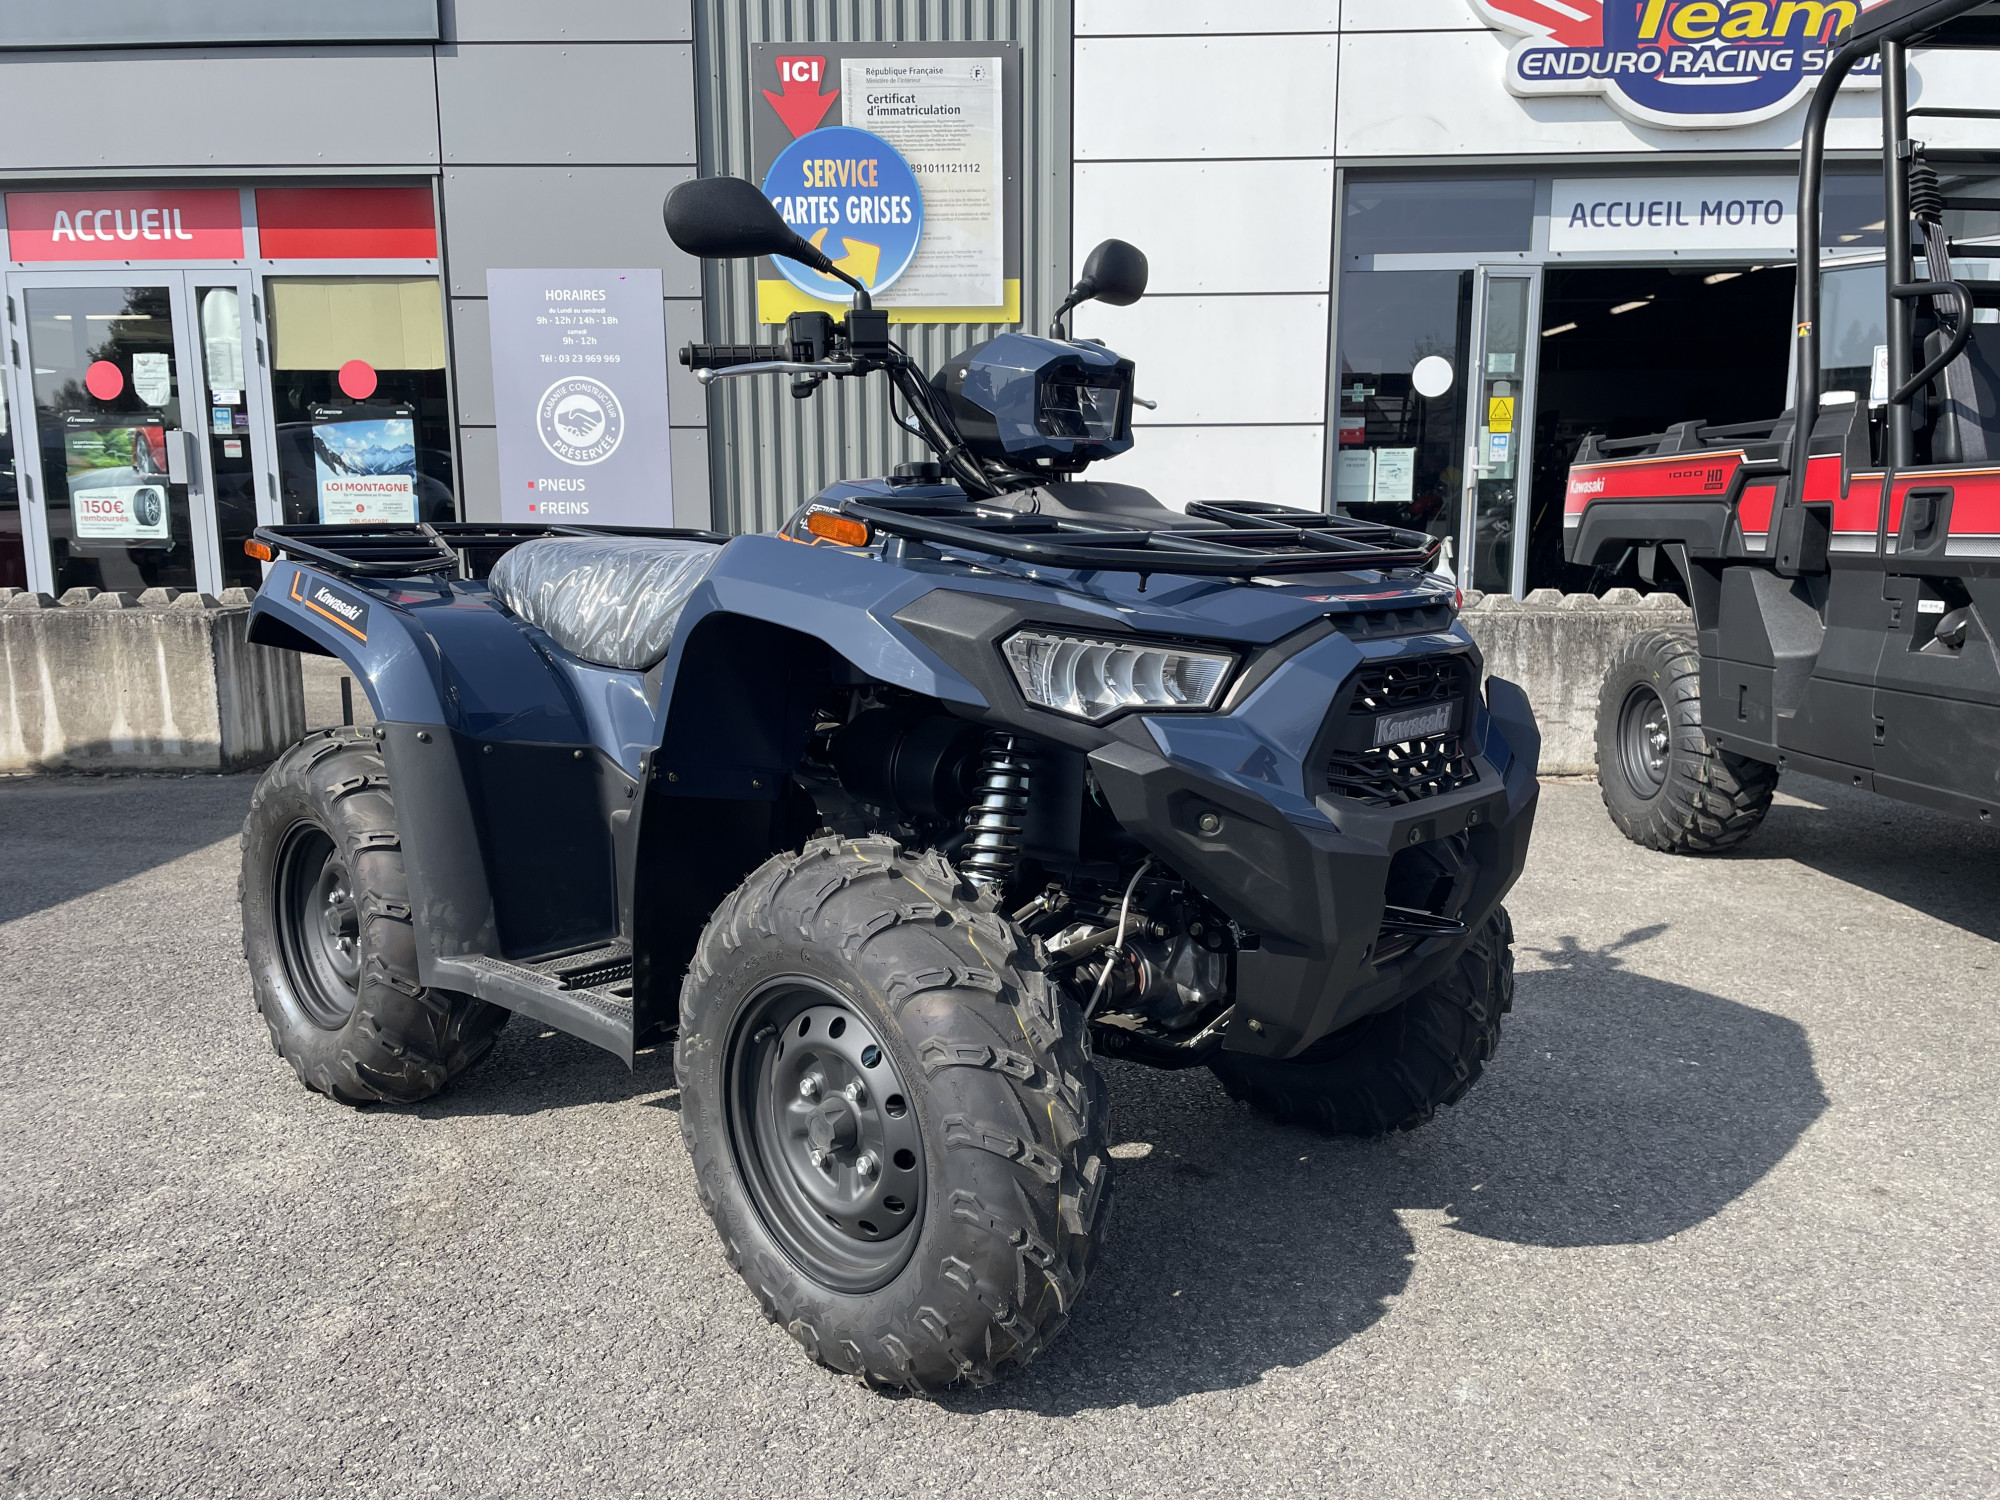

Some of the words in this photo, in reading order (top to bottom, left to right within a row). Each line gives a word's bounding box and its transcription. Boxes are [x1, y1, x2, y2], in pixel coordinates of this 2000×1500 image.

[1522, 49, 1662, 75] ENDURO
[1669, 48, 1794, 73] RACING
[783, 61, 819, 82] ICI
[866, 67, 907, 77] République
[909, 66, 944, 77] Française
[866, 93, 916, 104] Certificat
[867, 104, 961, 116] d'immatriculation
[802, 159, 878, 188] SERVICE
[771, 196, 840, 224] CARTES
[846, 196, 912, 224] GRISES
[1568, 201, 1689, 228] ACCUEIL
[1700, 199, 1784, 226] MOTO
[52, 208, 193, 241] ACCUEIL
[545, 289, 606, 301] HORAIRES
[536, 316, 547, 325] 9h
[554, 316, 571, 325] 12h
[578, 316, 595, 325] 14h
[601, 316, 618, 325] 18h
[562, 336, 574, 345] 9h
[580, 336, 597, 345] 12h
[558, 354, 570, 363] 03
[572, 354, 583, 363] 23
[585, 354, 602, 363] 969
[603, 354, 621, 363] 969
[543, 386, 568, 418] GARANTIE
[568, 383, 617, 418] CONSTRUCTEUR
[552, 434, 616, 460] PRÉSERVÉE
[1668, 470, 1703, 478] 1000
[1706, 468, 1723, 482] HD
[326, 482, 343, 491] LOI
[345, 483, 409, 492] MONTAGNE
[538, 478, 586, 492] PNEUS
[1570, 476, 1606, 494] Kawasaki
[84, 500, 125, 514] 150€
[540, 501, 590, 515] FREINS
[80, 514, 130, 522] remboursés
[314, 586, 363, 621] Kawasaki
[1377, 706, 1451, 743] Kawasaki
